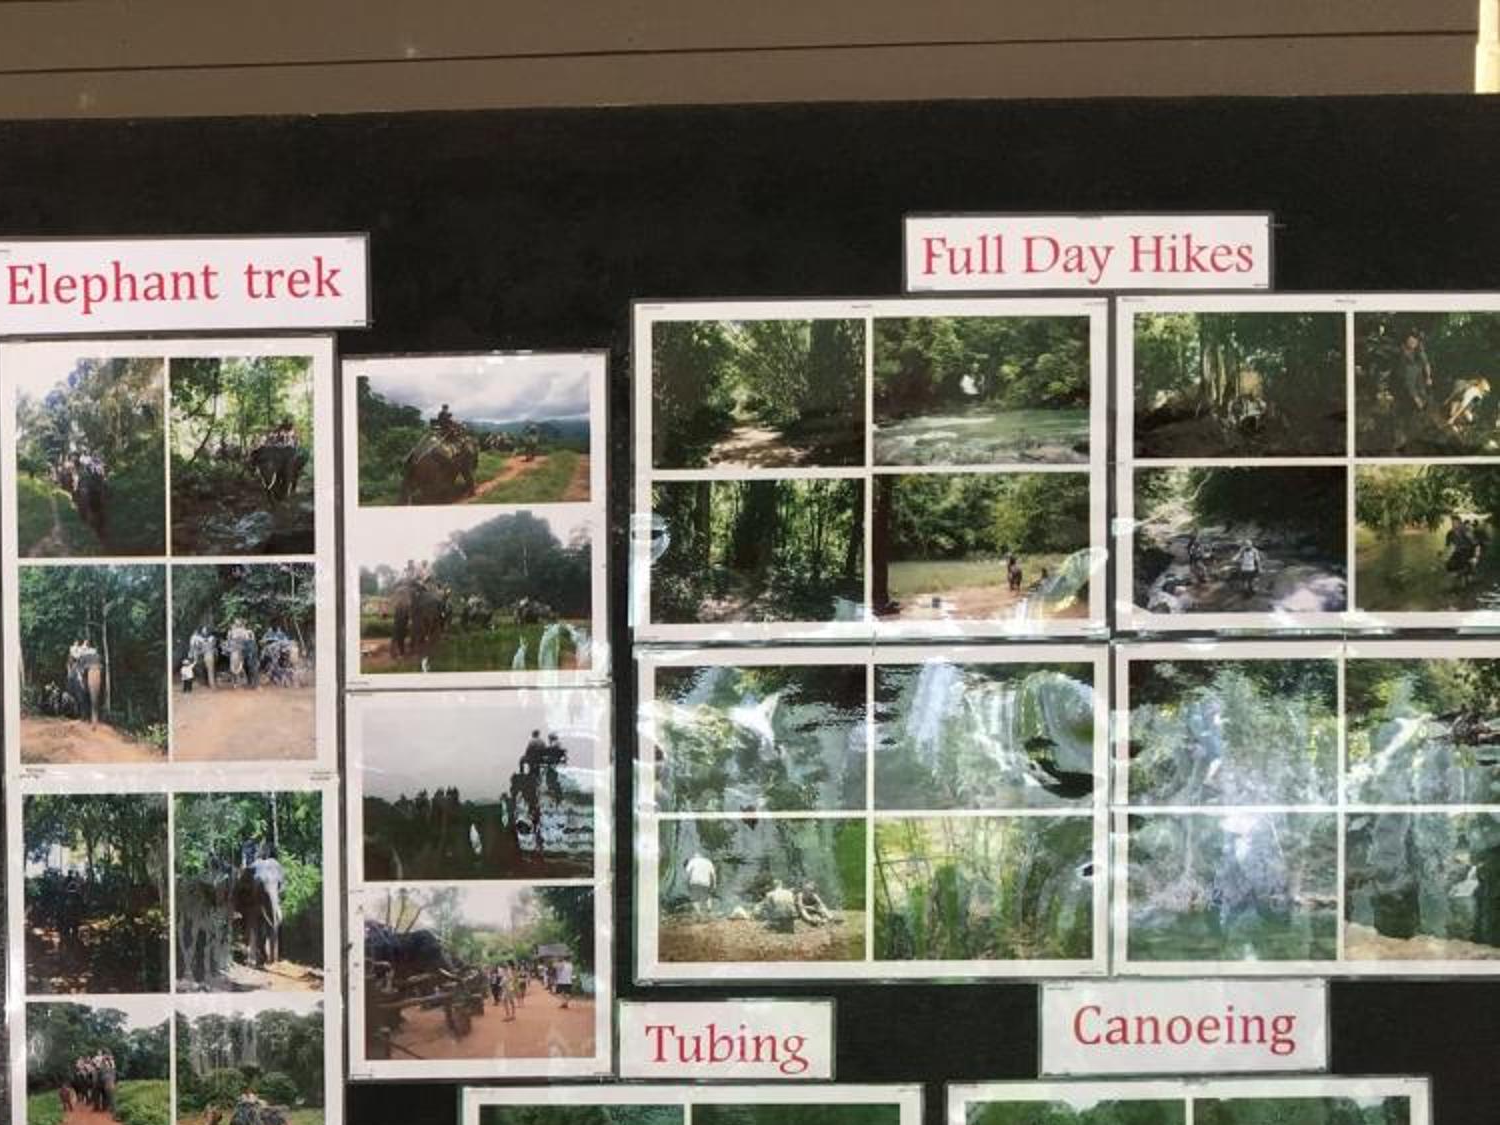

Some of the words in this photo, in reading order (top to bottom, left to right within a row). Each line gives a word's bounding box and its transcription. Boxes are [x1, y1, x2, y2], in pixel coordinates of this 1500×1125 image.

[921, 233, 1007, 276] Full
[1021, 235, 1116, 285] Day
[1128, 232, 1255, 274] Hikes
[6, 260, 219, 316] Elephant
[243, 255, 343, 301] trek
[644, 1023, 810, 1074] Tubing
[1072, 1004, 1297, 1056] Canoeing
